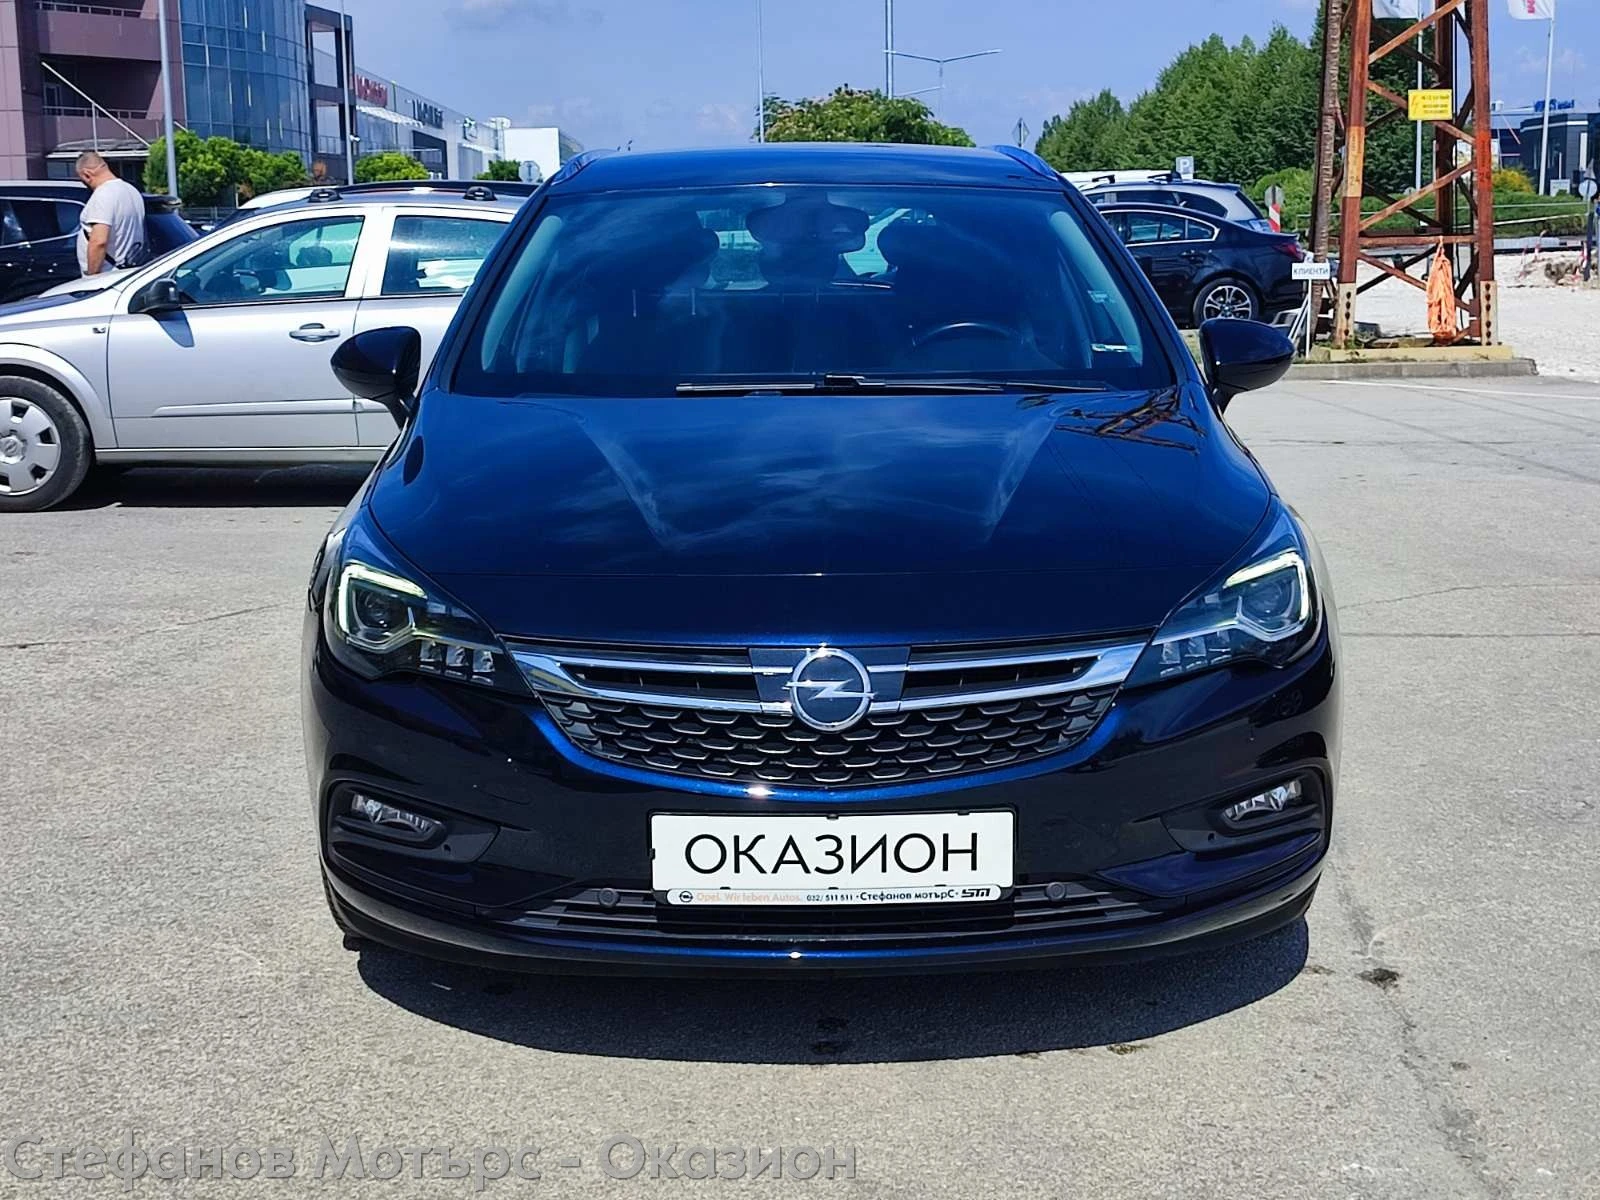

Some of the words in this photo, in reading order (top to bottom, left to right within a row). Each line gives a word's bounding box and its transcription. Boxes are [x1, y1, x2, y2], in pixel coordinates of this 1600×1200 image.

[1293, 267, 1329, 275] КЛИЕНТИ
[684, 832, 978, 875] ОКАЗИОН
[725, 892, 740, 901] Wir
[743, 892, 770, 901] leben
